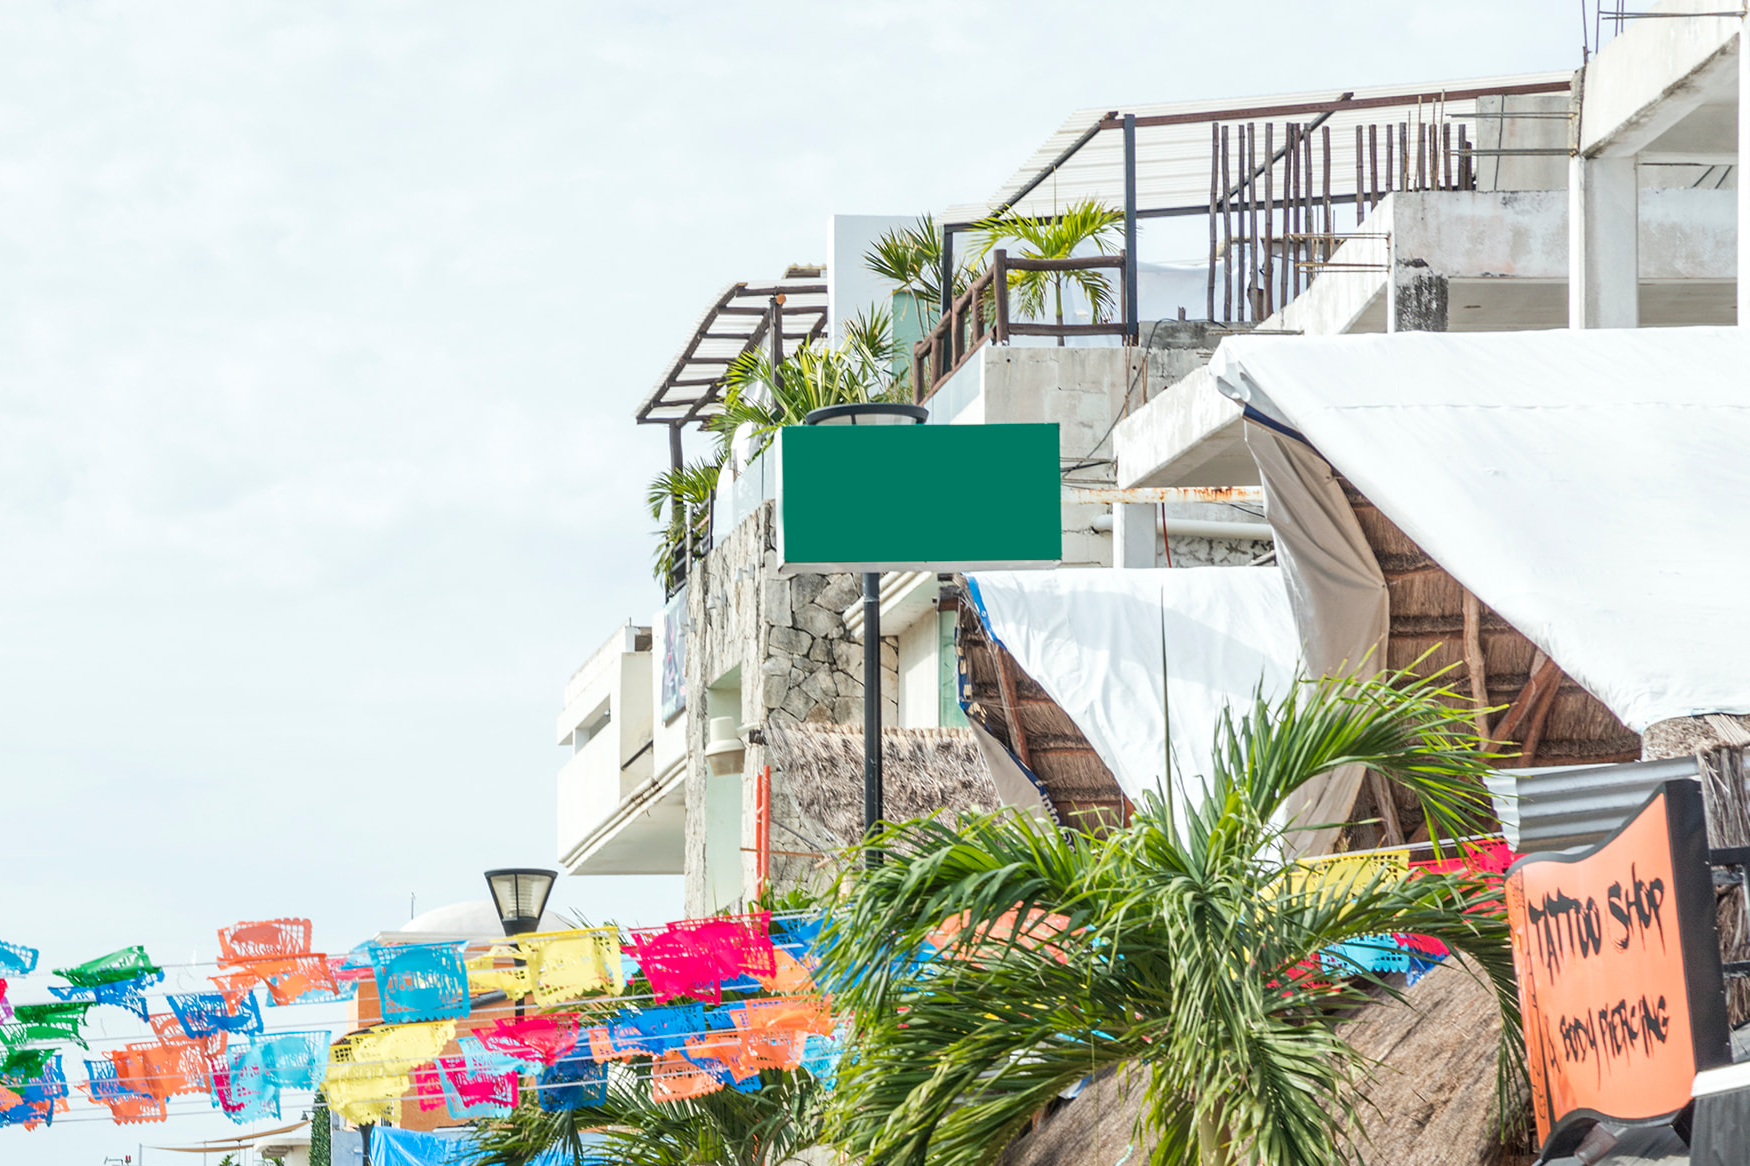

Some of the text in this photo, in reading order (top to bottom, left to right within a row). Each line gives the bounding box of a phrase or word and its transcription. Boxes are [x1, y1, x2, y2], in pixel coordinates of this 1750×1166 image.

[1528, 862, 1666, 986] TATTOO SHOP
[1559, 1008, 1601, 1090] BODY
[1599, 995, 1670, 1073] PIERCING
